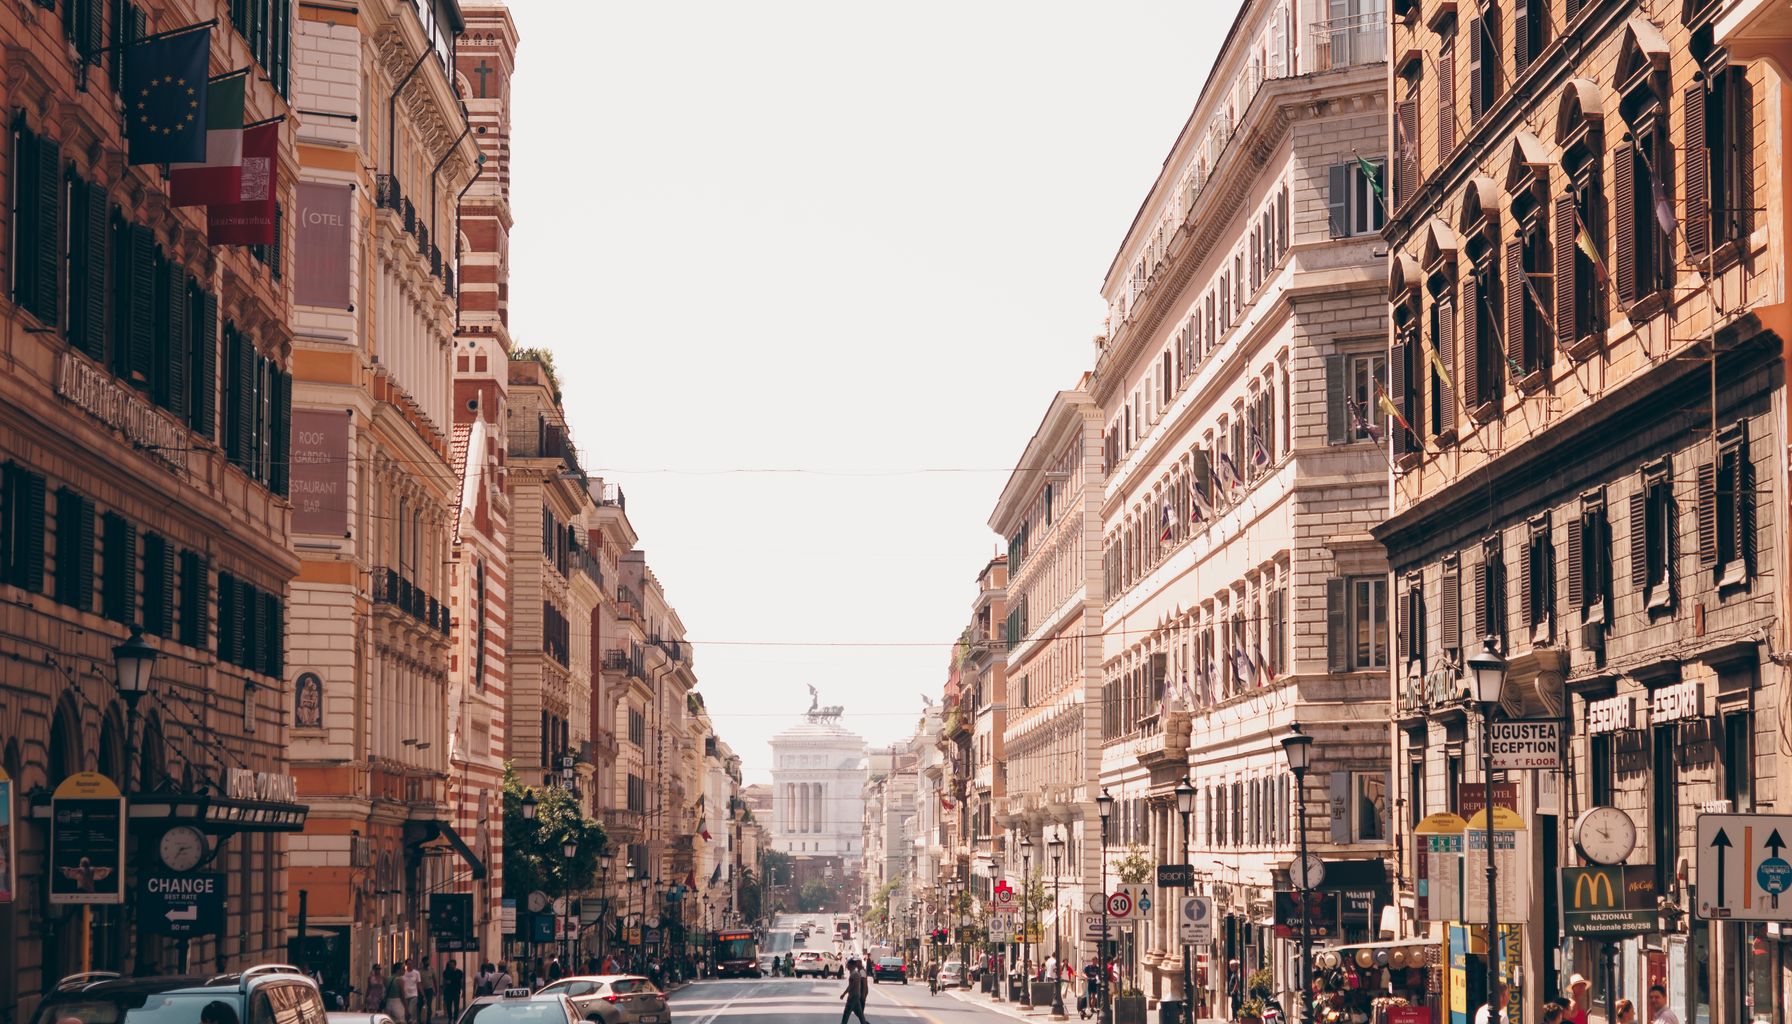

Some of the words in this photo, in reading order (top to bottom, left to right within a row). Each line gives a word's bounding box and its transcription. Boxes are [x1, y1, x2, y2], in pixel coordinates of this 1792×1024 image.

[299, 432, 324, 445] ROOF
[295, 450, 331, 463] GARDEN
[290, 480, 337, 494] ESTAURANT
[1654, 679, 1697, 722] ESEDRA
[1590, 697, 1629, 733] ESEDRA
[1483, 724, 1556, 740] UGUSTEA
[1483, 741, 1556, 754] ECEPTION
[1525, 758, 1556, 766] FLOOR
[148, 878, 214, 893] CHANGE
[1112, 898, 1127, 911] 30
[1591, 913, 1633, 921] NAZIONALE
[1573, 924, 1585, 932] Via
[1586, 923, 1622, 931] Nazionale
